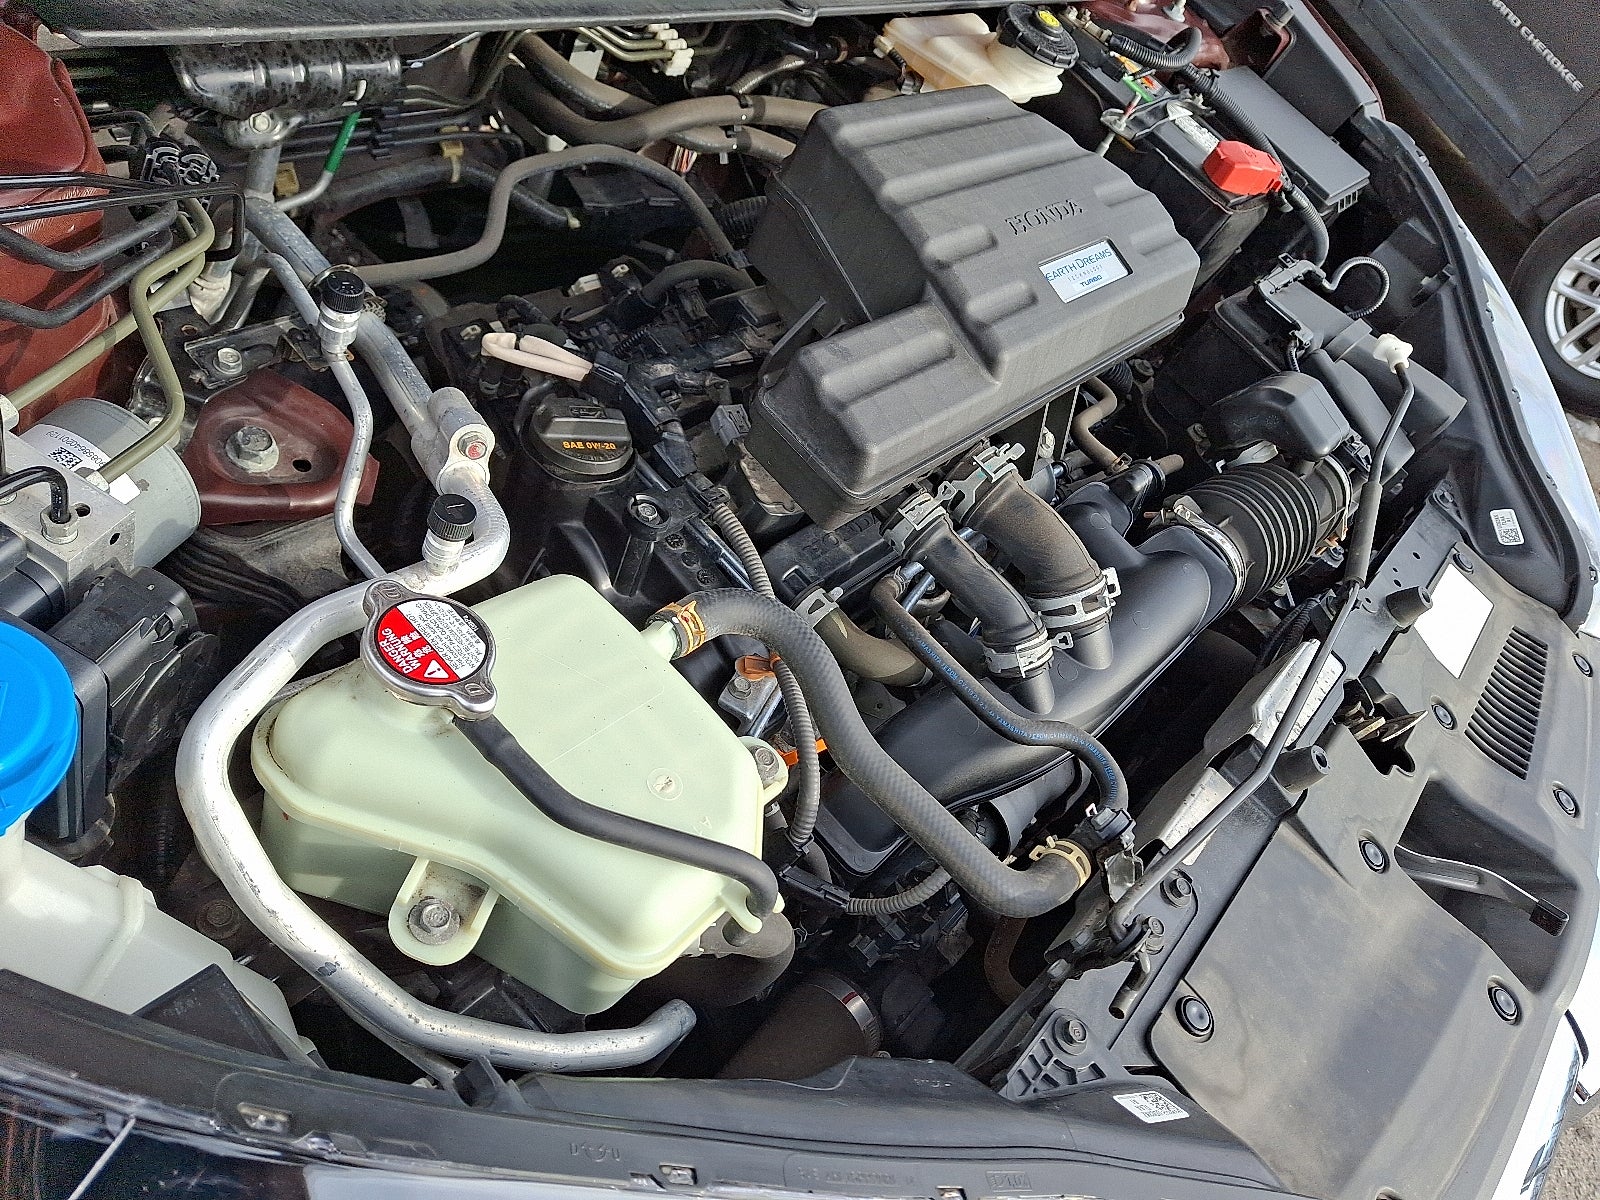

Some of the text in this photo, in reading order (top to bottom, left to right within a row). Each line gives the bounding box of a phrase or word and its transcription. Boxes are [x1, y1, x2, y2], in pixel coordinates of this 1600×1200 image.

[1520, 26, 1584, 92] CHEROKEE
[1005, 199, 1083, 235] HONDA
[1045, 262, 1078, 282] EARTH
[562, 441, 616, 450] SAE 0W-20
[378, 638, 413, 674] DANGER
[380, 626, 422, 669] WARNUNG
[441, 651, 460, 670] NEVER
[996, 716, 1028, 737] YAMASHITA
